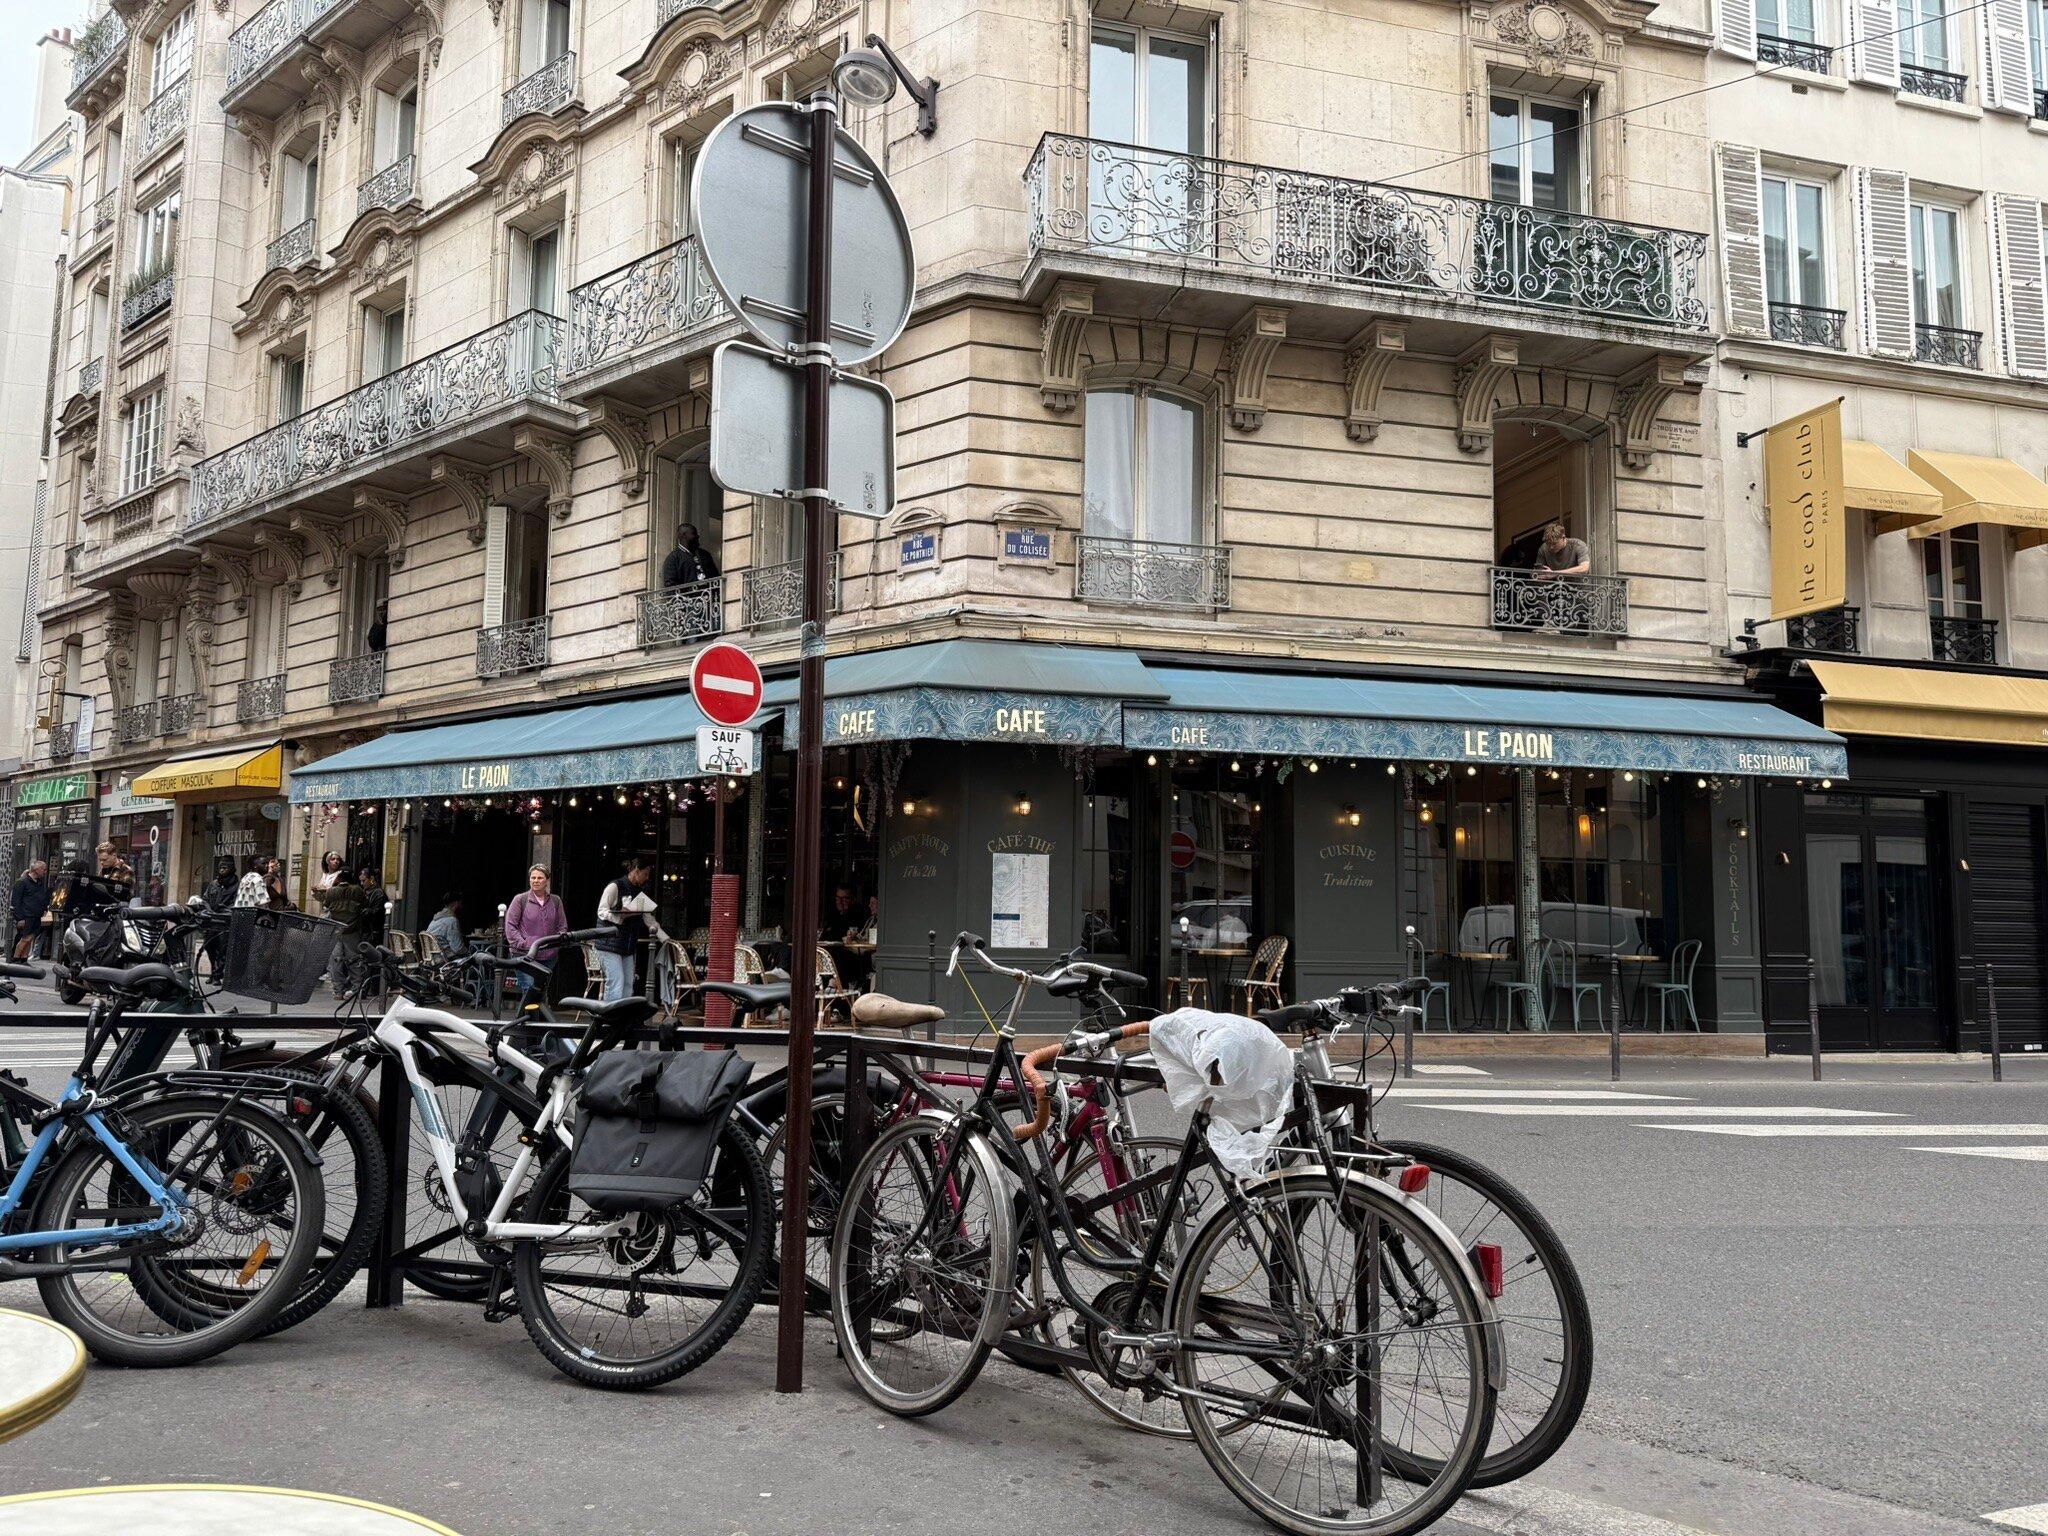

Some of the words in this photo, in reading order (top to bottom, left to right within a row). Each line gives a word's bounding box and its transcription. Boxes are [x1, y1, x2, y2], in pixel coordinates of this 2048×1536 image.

[1796, 424, 1812, 480] club
[913, 539, 923, 549] RUE
[1021, 534, 1034, 544] RUE
[902, 552, 909, 562] DE
[1007, 544, 1016, 553] DU
[1019, 544, 1047, 556] COLISÉE
[1800, 562, 1815, 601] the
[839, 710, 876, 736] CAFE
[996, 708, 1046, 734] CAFE
[712, 731, 741, 743] SAUF
[1171, 726, 1209, 745] CAFE
[1464, 730, 1490, 757] LE
[1499, 732, 1553, 760] PAON
[1738, 752, 1811, 772] RESTAURANT
[151, 778, 177, 791] COIFFURE
[181, 774, 214, 788] MASCULINE
[462, 767, 476, 789] LE
[480, 765, 510, 787] PAON
[306, 783, 339, 798] RESTAURANT
[217, 829, 255, 844] COIFFURE
[213, 843, 258, 857] MASCULINE
[889, 835, 920, 858] HAPPY
[921, 834, 949, 856] HOUR
[1320, 844, 1376, 861] CUISINE
[1344, 861, 1354, 871] de
[1324, 873, 1375, 887] Tradition
[1728, 842, 1740, 946] COCKTAILS
